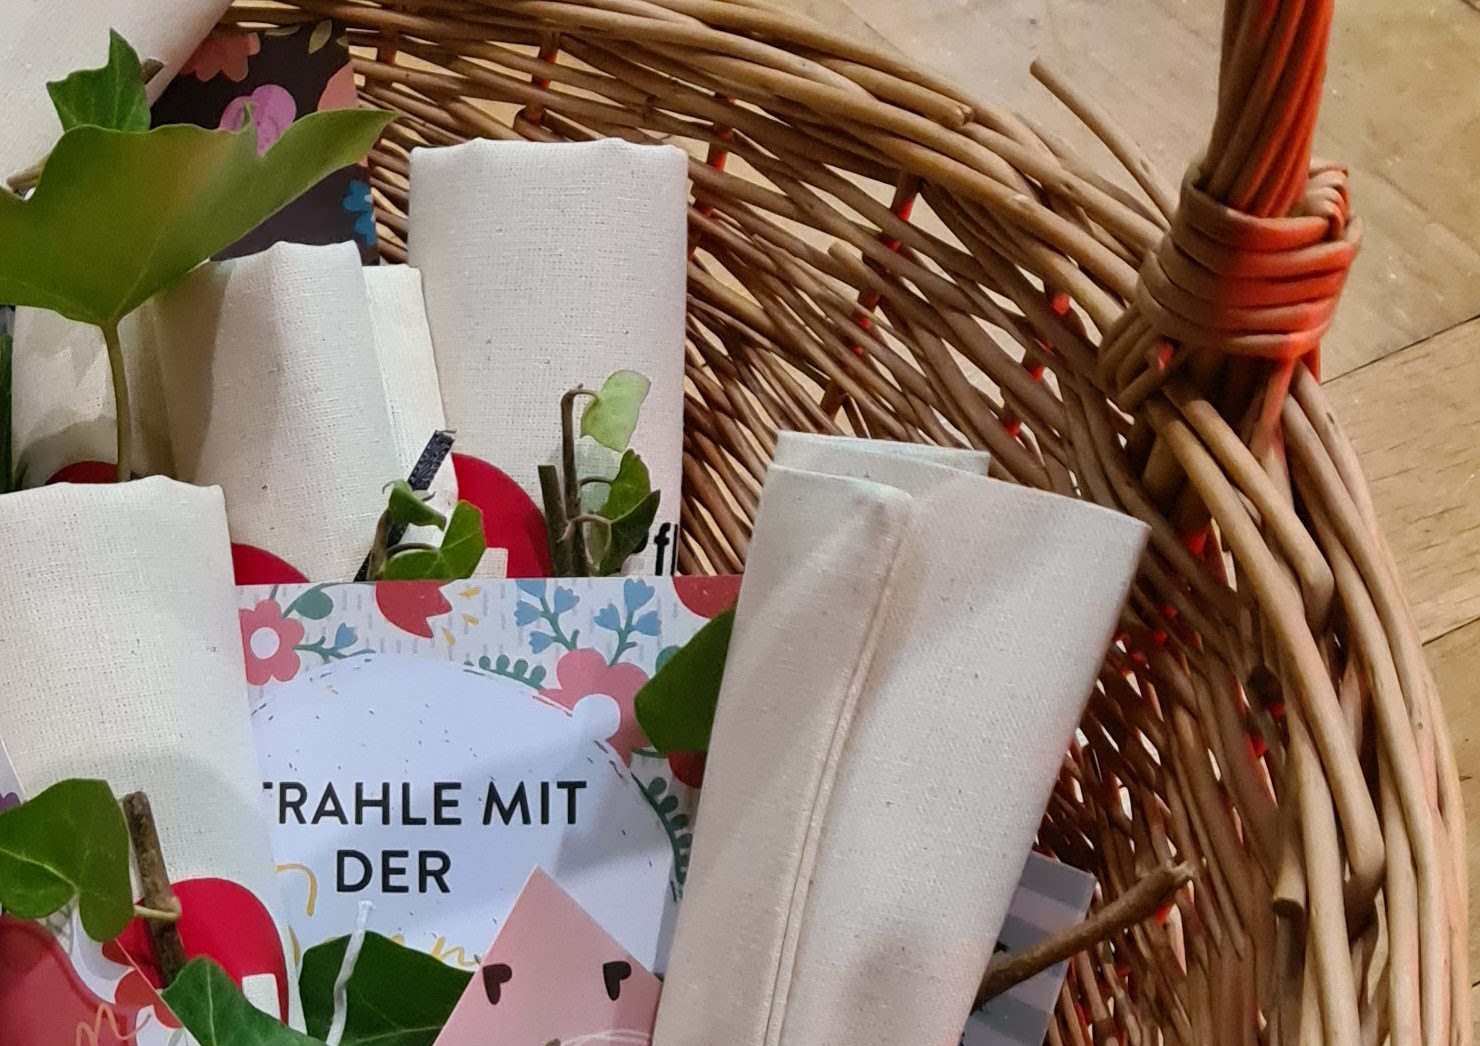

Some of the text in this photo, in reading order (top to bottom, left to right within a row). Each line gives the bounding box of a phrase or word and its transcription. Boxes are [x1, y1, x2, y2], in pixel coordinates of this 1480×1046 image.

[263, 781, 587, 825] RAHLE MIT
[336, 849, 452, 893] DER
